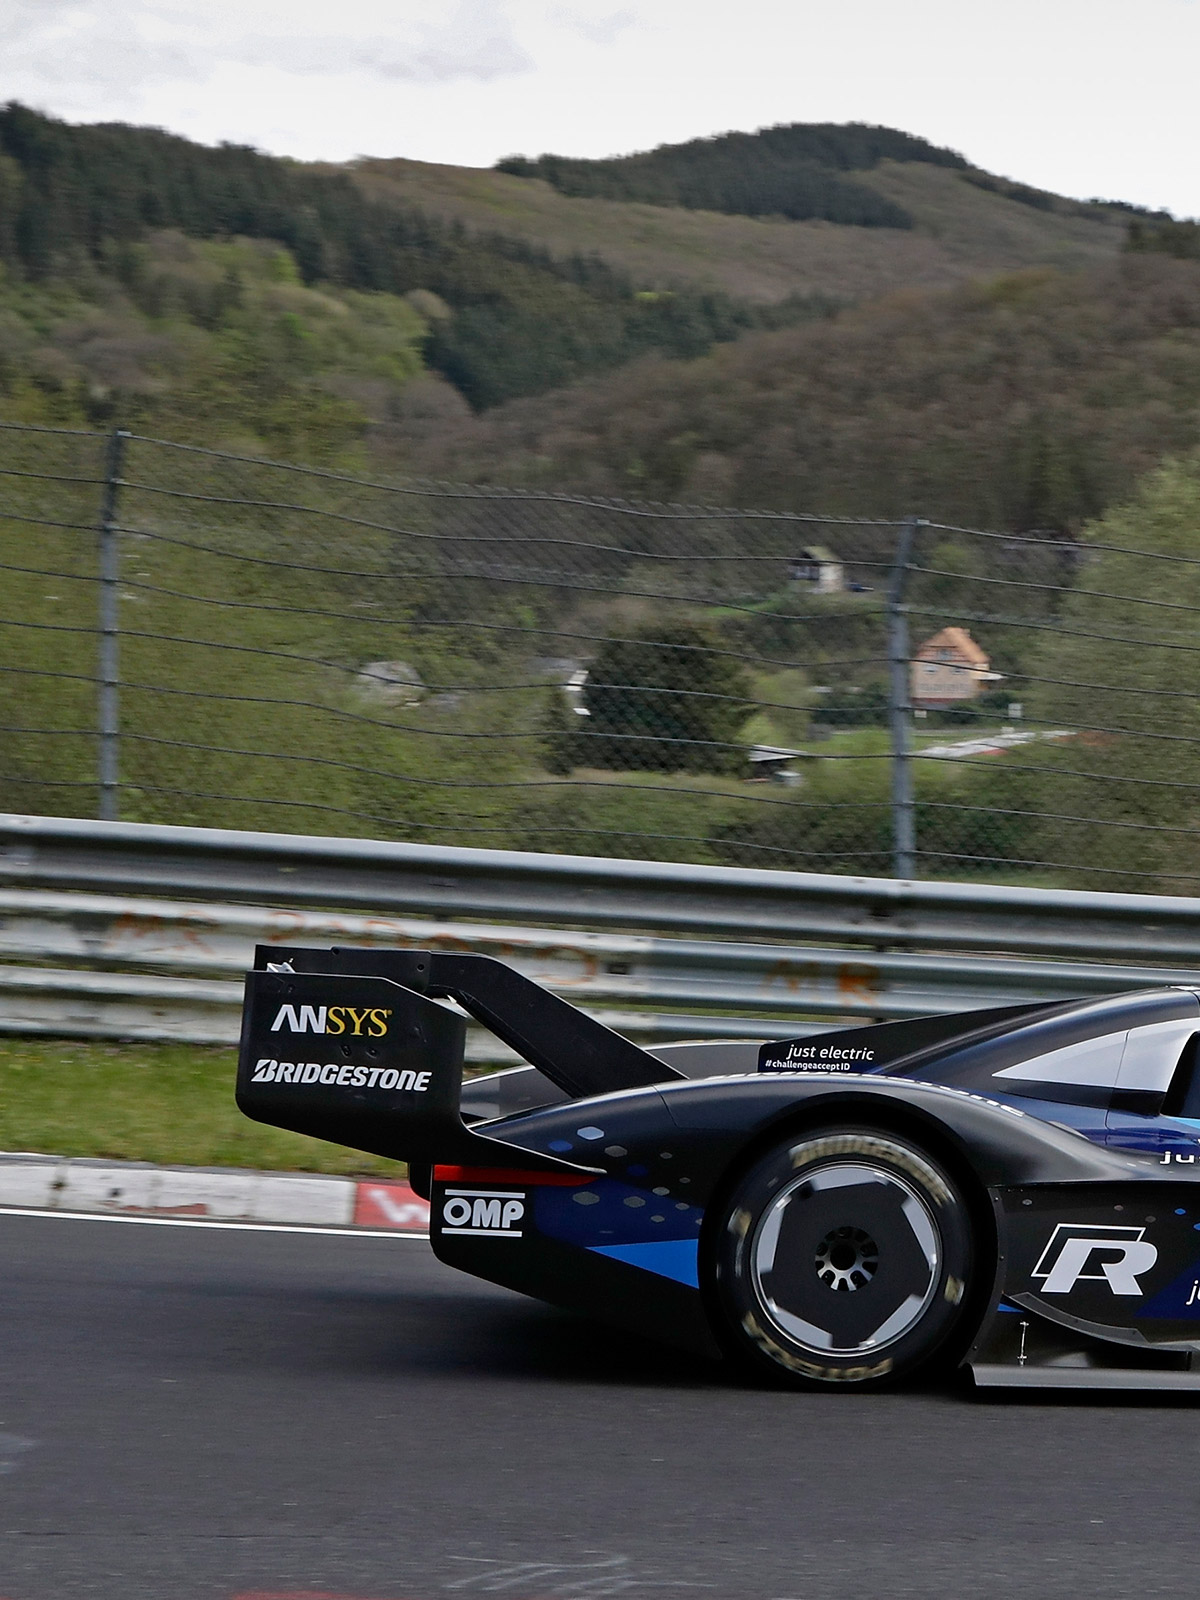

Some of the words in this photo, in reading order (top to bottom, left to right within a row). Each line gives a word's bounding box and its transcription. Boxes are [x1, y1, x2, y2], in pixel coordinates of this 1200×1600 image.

[271, 1004, 388, 1037] ANSYS
[786, 1044, 816, 1060] just
[820, 1046, 874, 1060] electric
[251, 1059, 432, 1091] BRIDGESTONE
[443, 1197, 525, 1229] OMP
[1036, 1232, 1158, 1296] R
